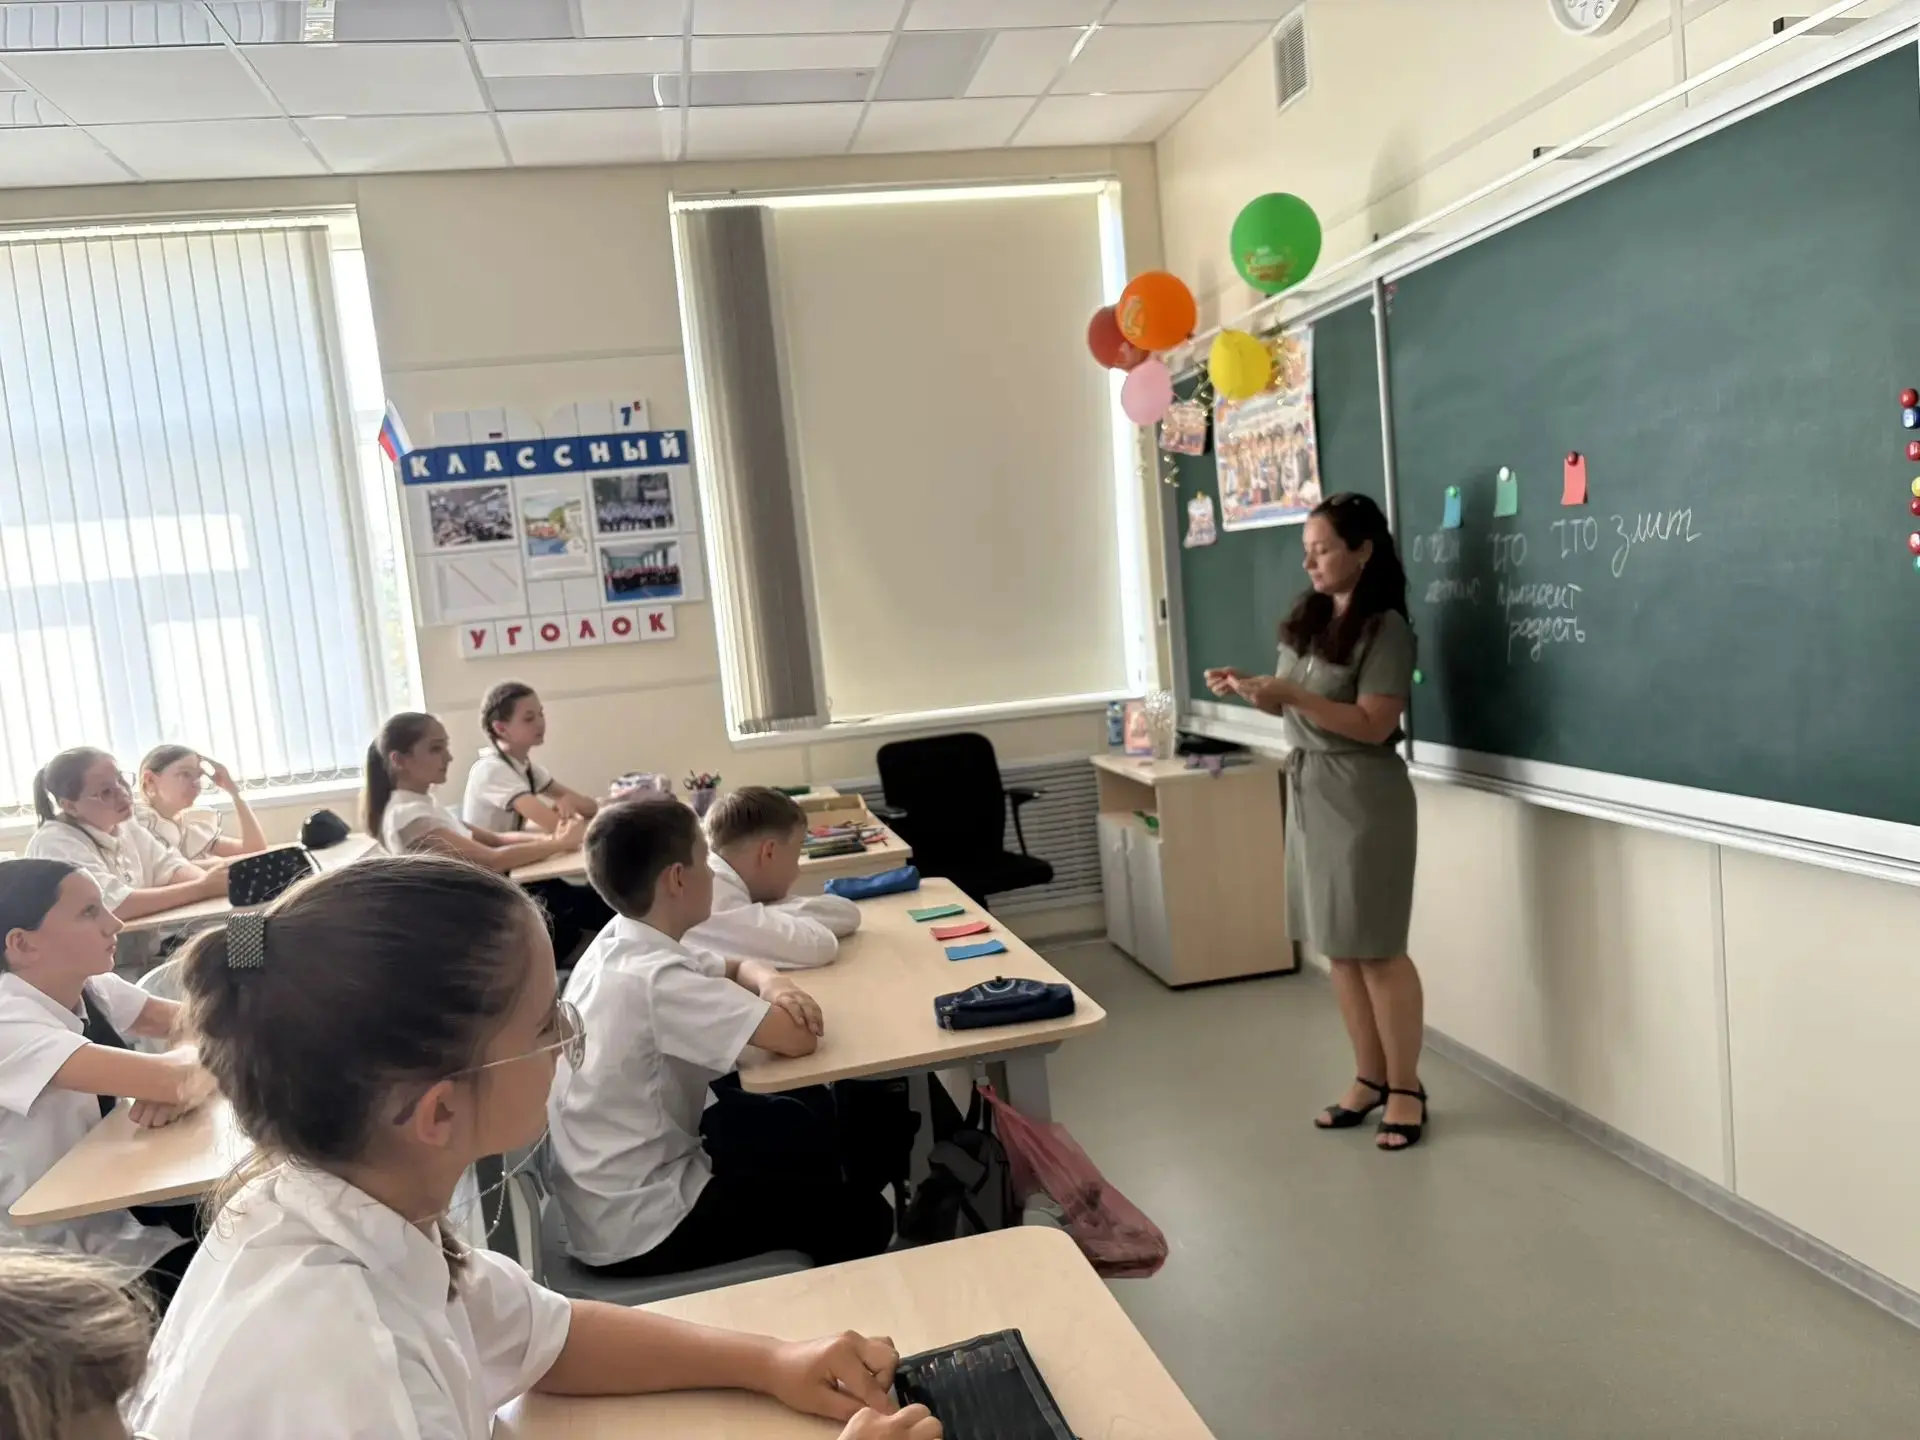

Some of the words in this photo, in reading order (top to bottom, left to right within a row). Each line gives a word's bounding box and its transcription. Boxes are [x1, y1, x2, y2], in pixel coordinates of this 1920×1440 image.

[409, 432, 682, 479] КЛАССНЫЙ
[469, 612, 668, 650] УГОЛОК
[1506, 615, 1587, 666] радость
